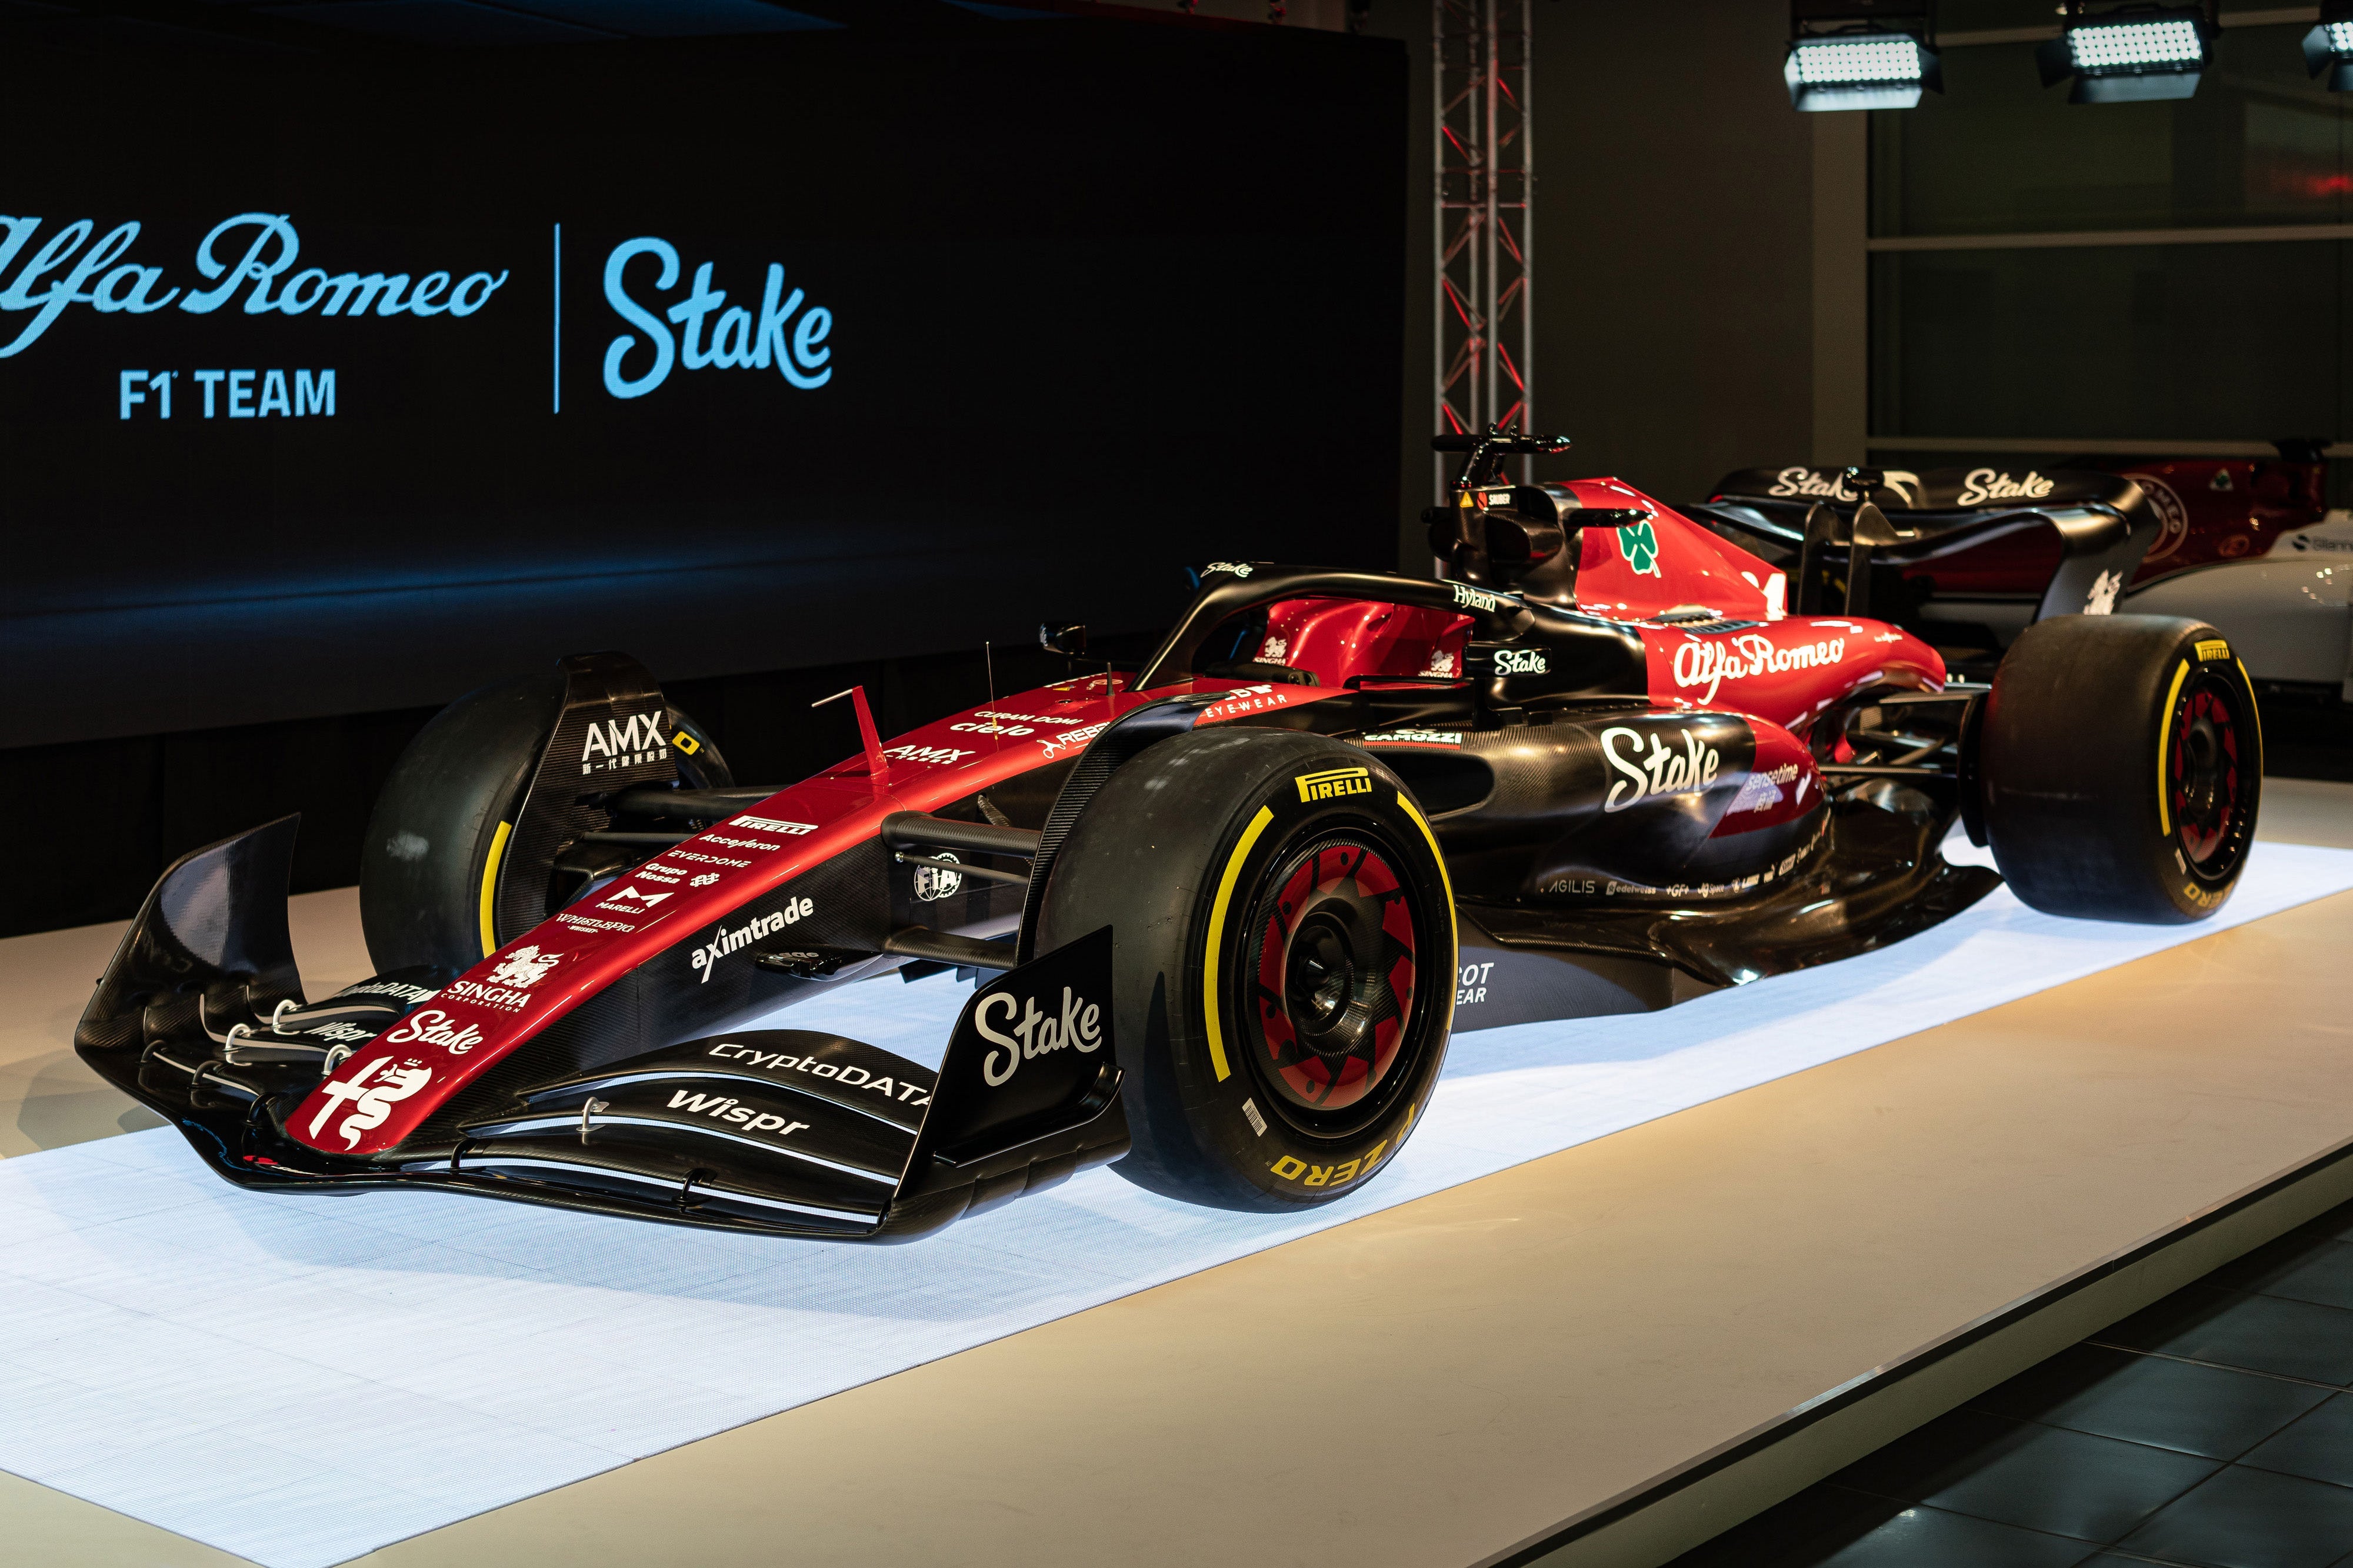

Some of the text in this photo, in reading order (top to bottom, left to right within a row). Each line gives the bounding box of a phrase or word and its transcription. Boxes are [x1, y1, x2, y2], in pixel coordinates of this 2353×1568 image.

[178, 212, 509, 317] Romeo
[602, 236, 833, 399] Stake
[194, 369, 336, 418] TEAM
[1957, 468, 2055, 506] Stake
[1200, 562, 1254, 578] Stake
[1452, 584, 1496, 613] Hyland
[1493, 649, 1547, 676] Stake
[2194, 639, 2231, 662] PIRELLI
[1674, 633, 1845, 706] Alfa Romeo
[974, 711, 1084, 725] CURAM DOMI
[1205, 693, 1288, 718] EYEWEAR
[581, 710, 666, 762] AMX
[1364, 732, 1462, 745] CAMOZZI
[882, 745, 976, 762] AMX
[1600, 727, 1719, 813] Stake
[1294, 767, 1372, 803] PIRELLI
[728, 815, 819, 836] PIRELLI
[634, 870, 681, 885] Nossa
[645, 863, 688, 876] Grupo
[1548, 880, 1595, 895] AGILIS
[595, 902, 645, 915] MARELLI
[691, 895, 814, 984] aximtrade
[441, 993, 521, 1013] CORPORATION
[447, 980, 531, 1007] SINGHA
[386, 1010, 484, 1055] Stake
[975, 986, 1102, 1087] Stake
[666, 1089, 811, 1136] Wispr
[1270, 1139, 1387, 1187] ZERO
